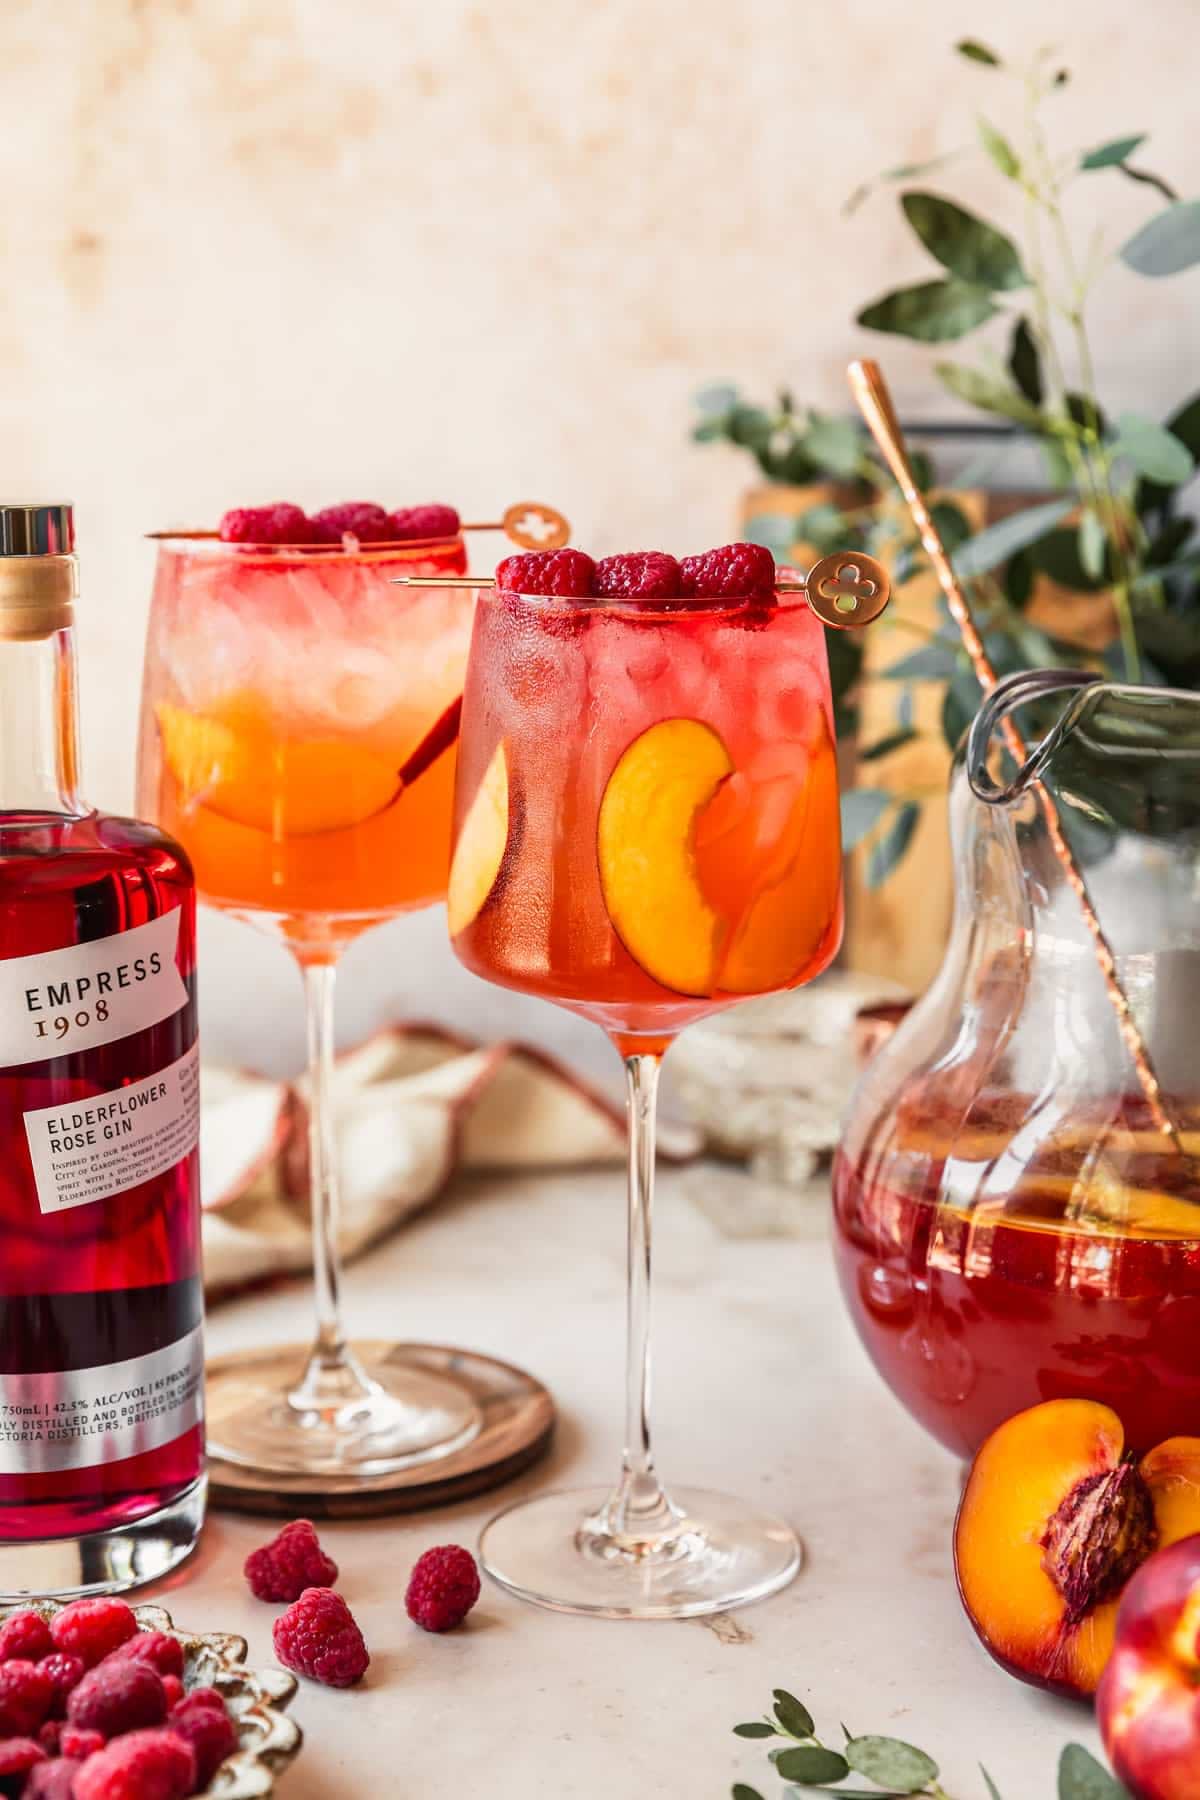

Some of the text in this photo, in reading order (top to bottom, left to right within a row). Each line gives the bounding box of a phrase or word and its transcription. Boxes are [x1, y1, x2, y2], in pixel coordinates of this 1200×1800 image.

[25, 952, 161, 1012] EMPRESS
[33, 999, 109, 1039] 1908
[47, 1082, 168, 1134] ELDERFLOWER
[50, 1118, 133, 1153] ROSE GIN
[2, 1403, 42, 1416] 750mL
[53, 1399, 89, 1413] 42.5%
[93, 1385, 147, 1408] ALC/VOL
[22, 1415, 88, 1430] DISTILLED
[93, 1409, 117, 1423] AND
[121, 1395, 164, 1417] BOTTLED
